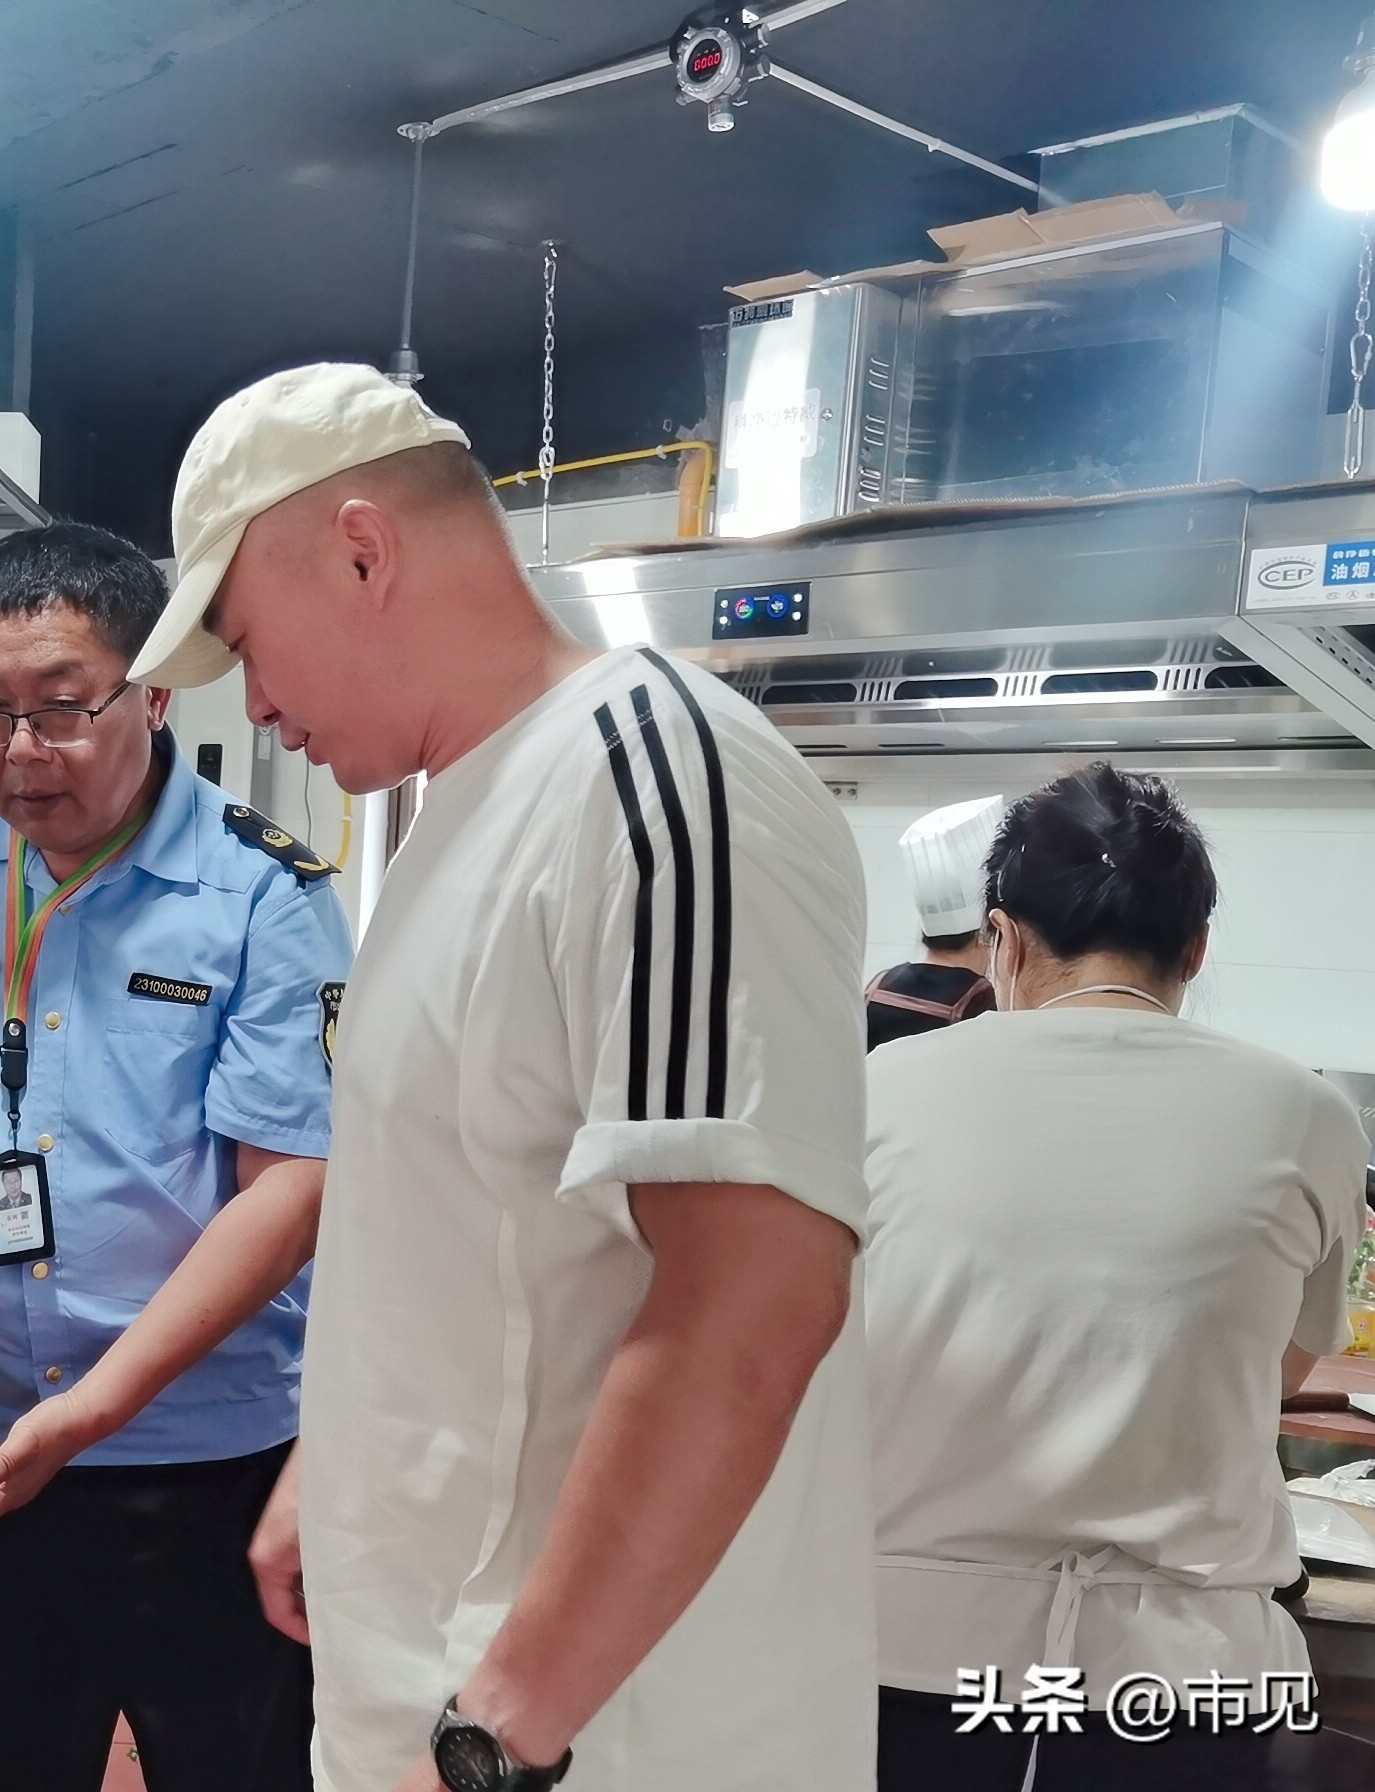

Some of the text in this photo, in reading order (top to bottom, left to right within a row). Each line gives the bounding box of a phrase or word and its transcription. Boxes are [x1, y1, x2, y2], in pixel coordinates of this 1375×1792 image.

[1265, 568, 1314, 583] CEP
[1330, 561, 1375, 580] 油烟
[133, 977, 208, 1001] 23100030046
